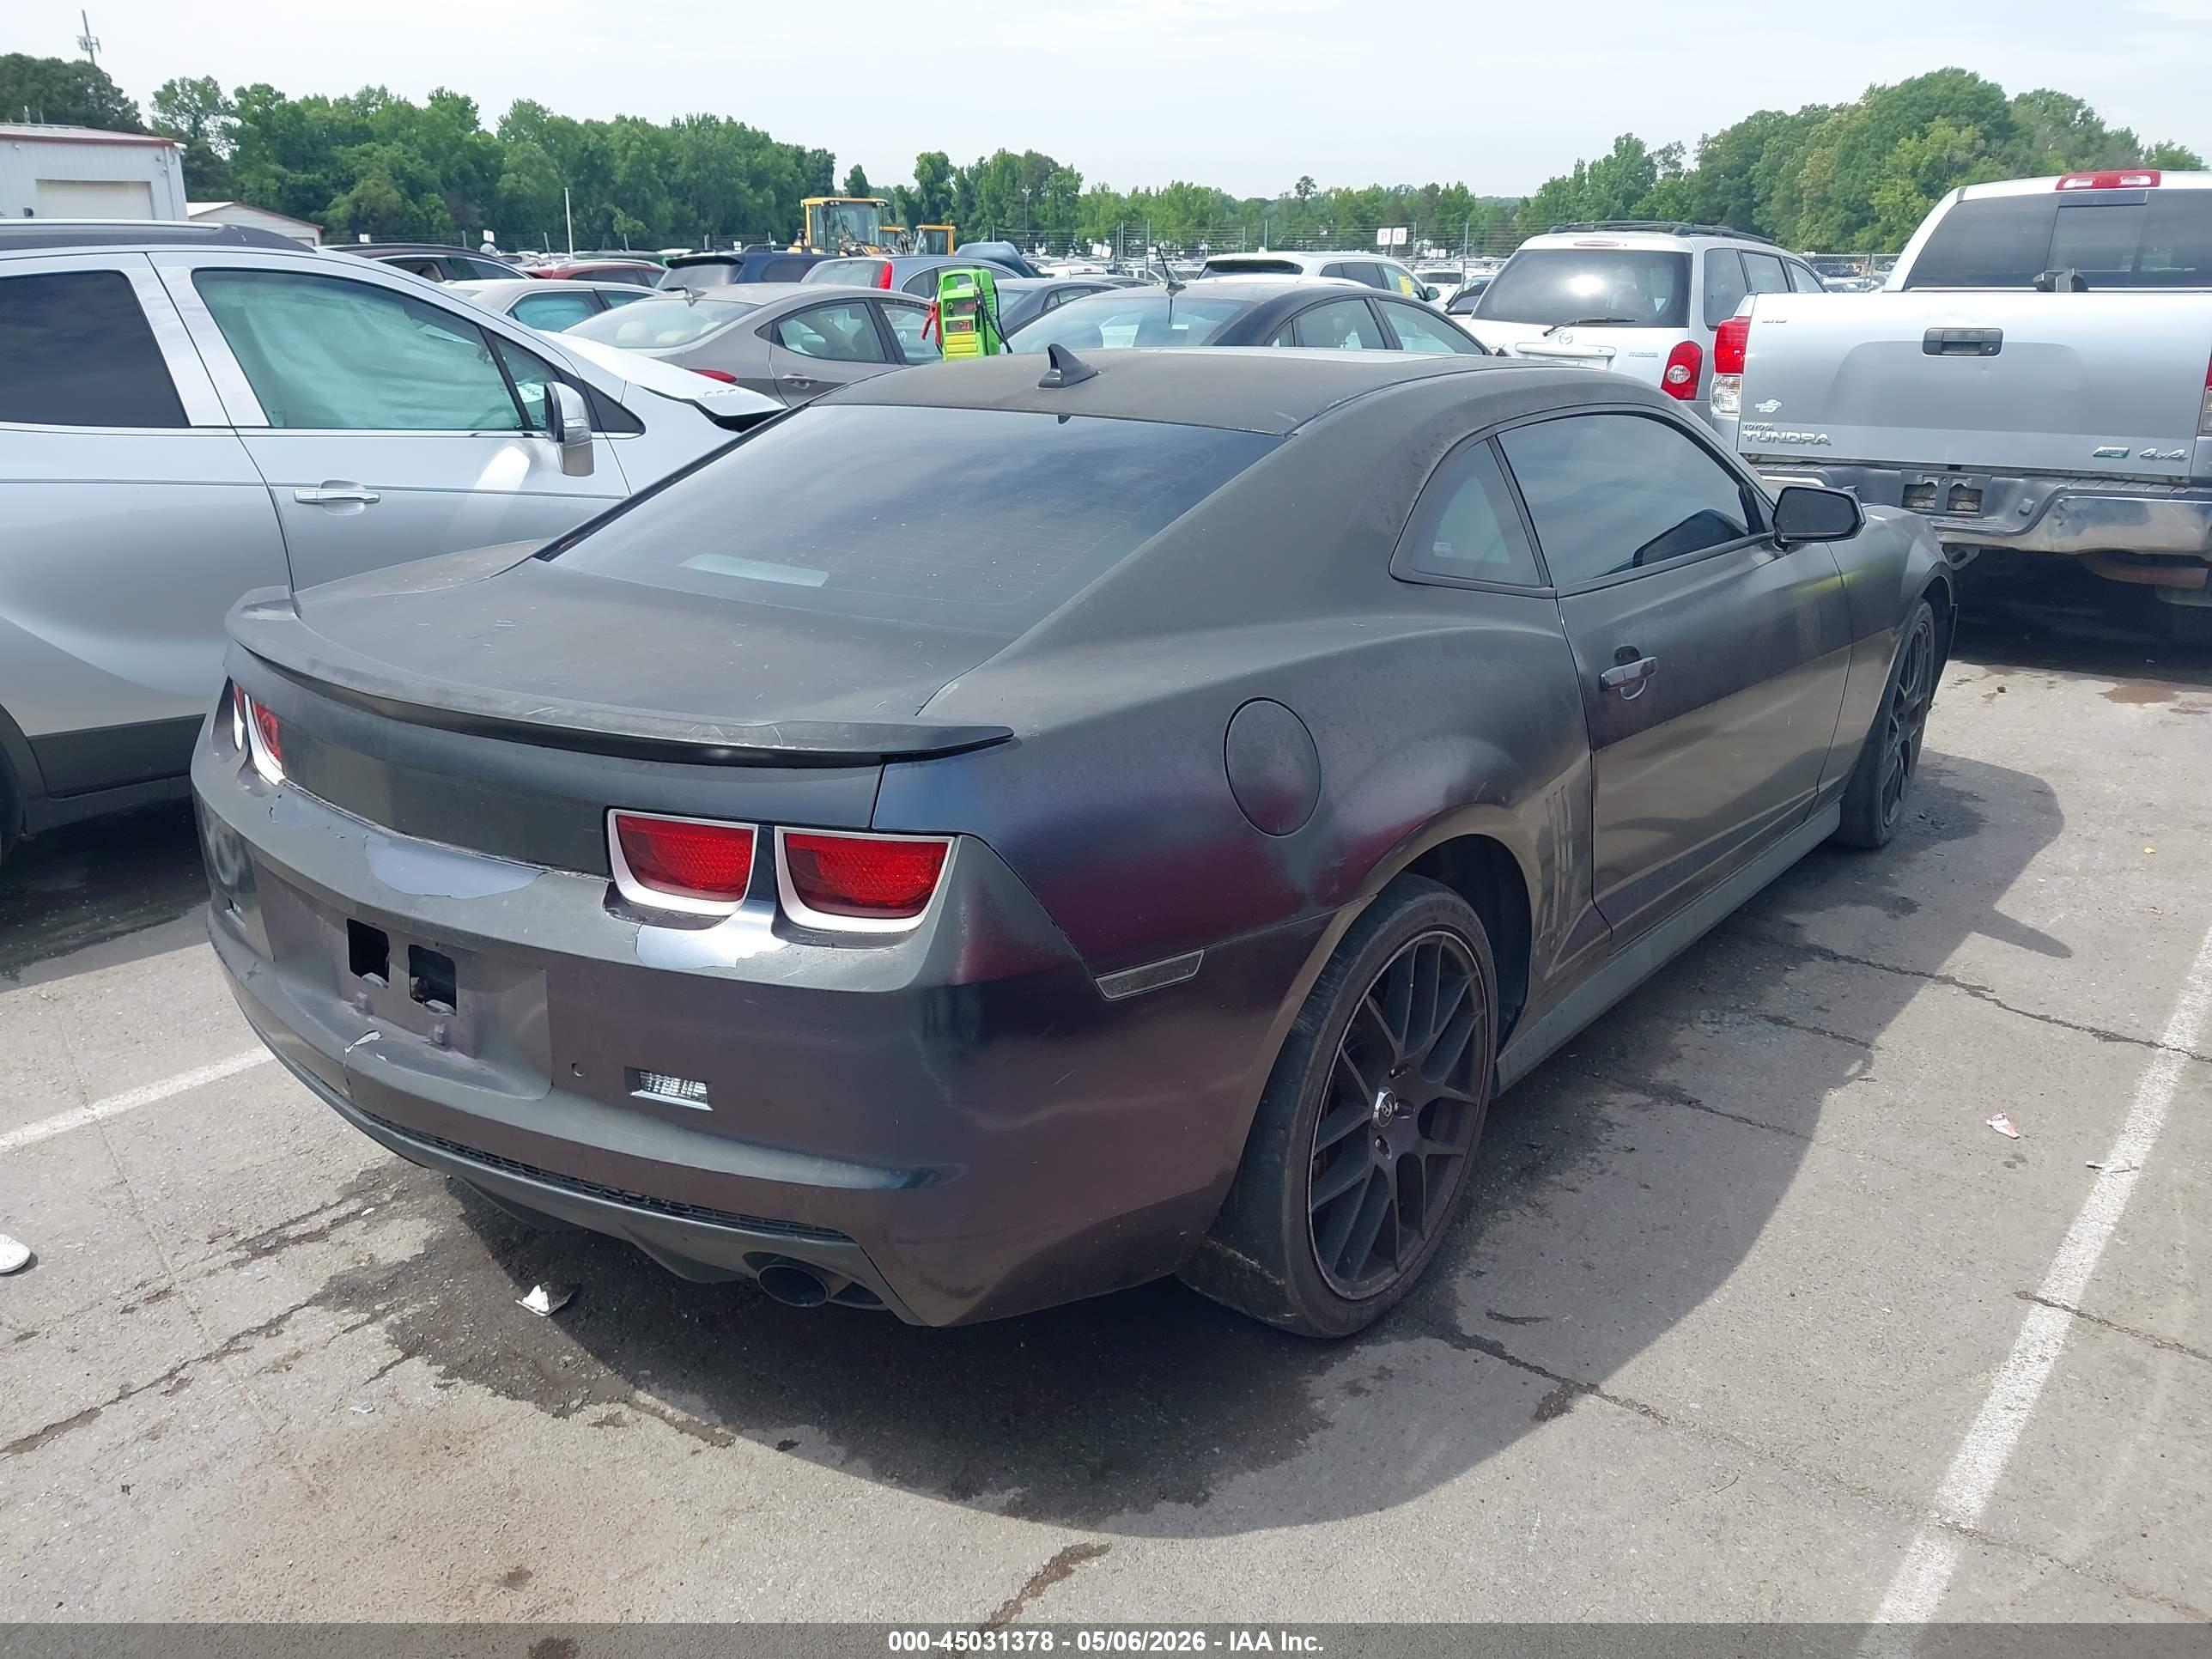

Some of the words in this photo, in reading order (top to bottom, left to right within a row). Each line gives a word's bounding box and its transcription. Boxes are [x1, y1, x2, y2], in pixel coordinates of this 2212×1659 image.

[1380, 232, 1388, 241] P
[1743, 422, 1773, 431] TOYOTA
[1741, 430, 1832, 446] TUNDRA
